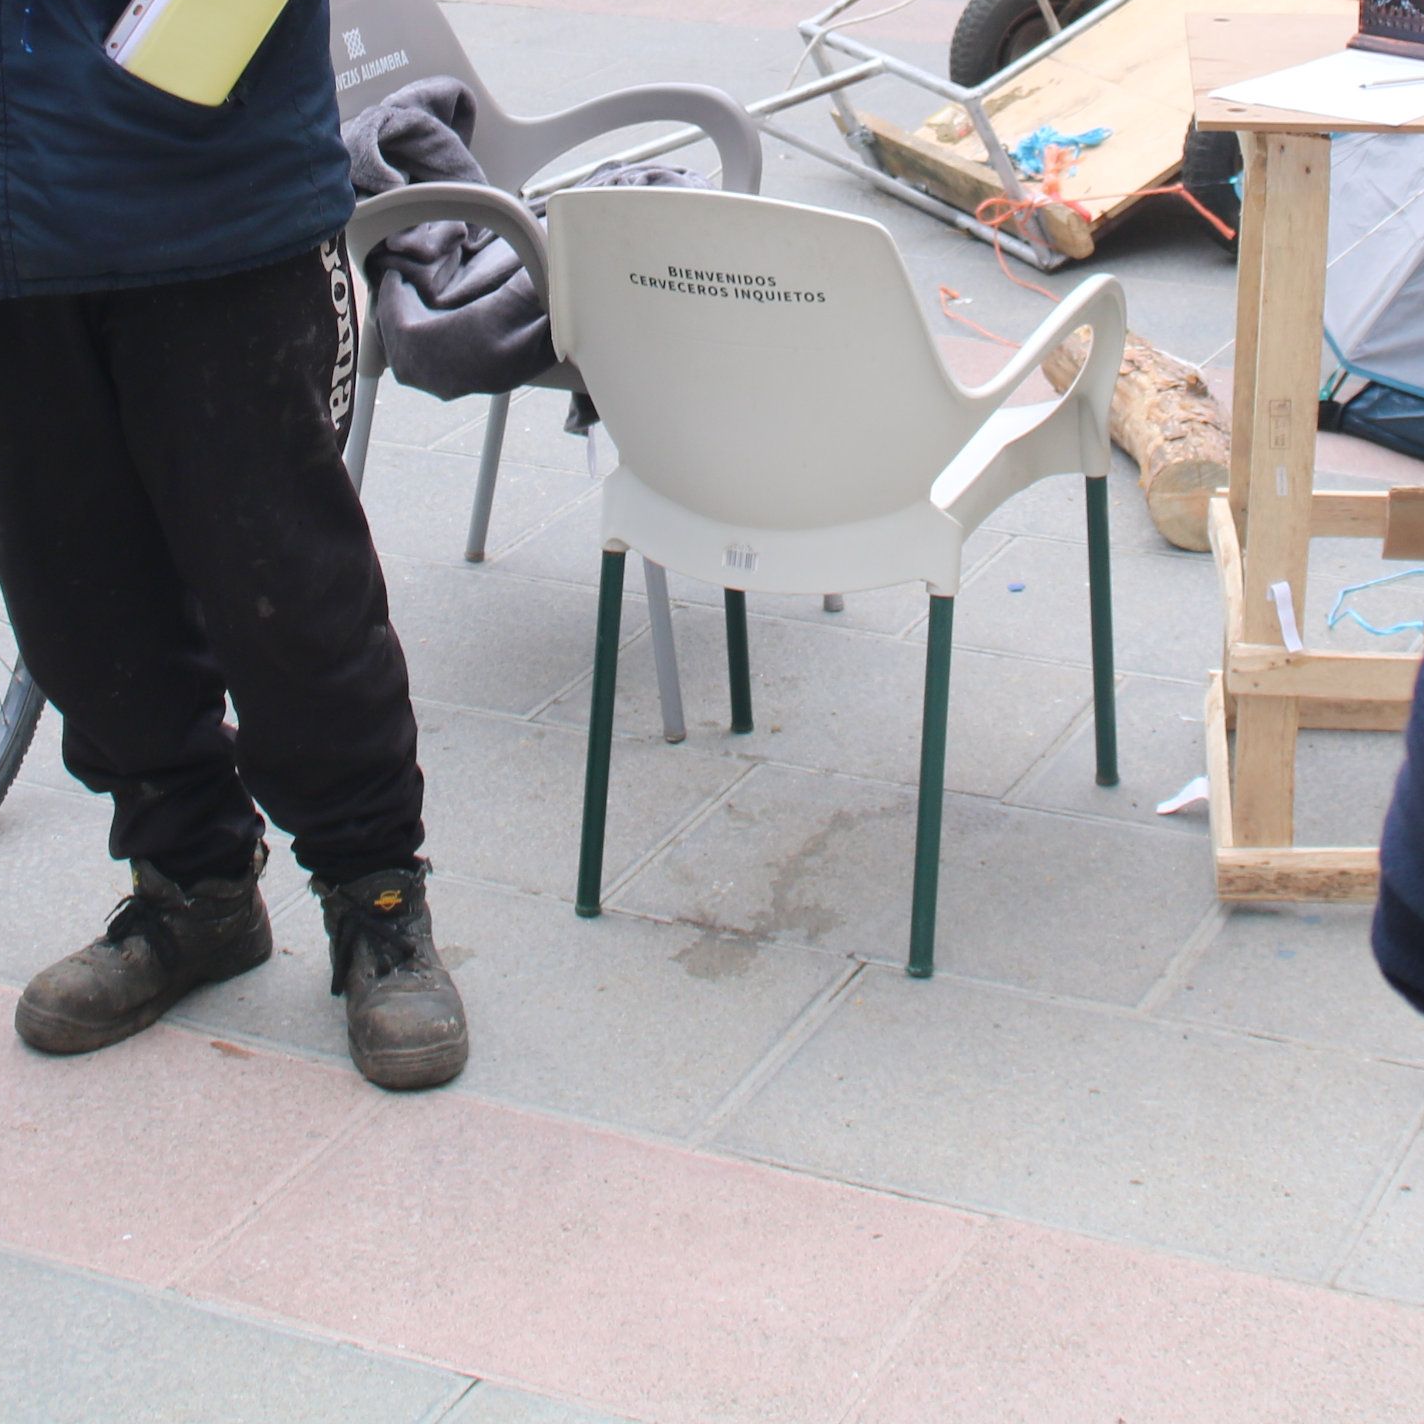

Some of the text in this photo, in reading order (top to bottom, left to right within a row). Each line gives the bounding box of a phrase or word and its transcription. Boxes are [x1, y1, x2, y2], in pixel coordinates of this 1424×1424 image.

[335, 49, 410, 92] VEZAS ALHAMBRA
[629, 272, 827, 304] CERVECEROS INQUIETOS
[667, 265, 777, 287] BIENVENIDOS
